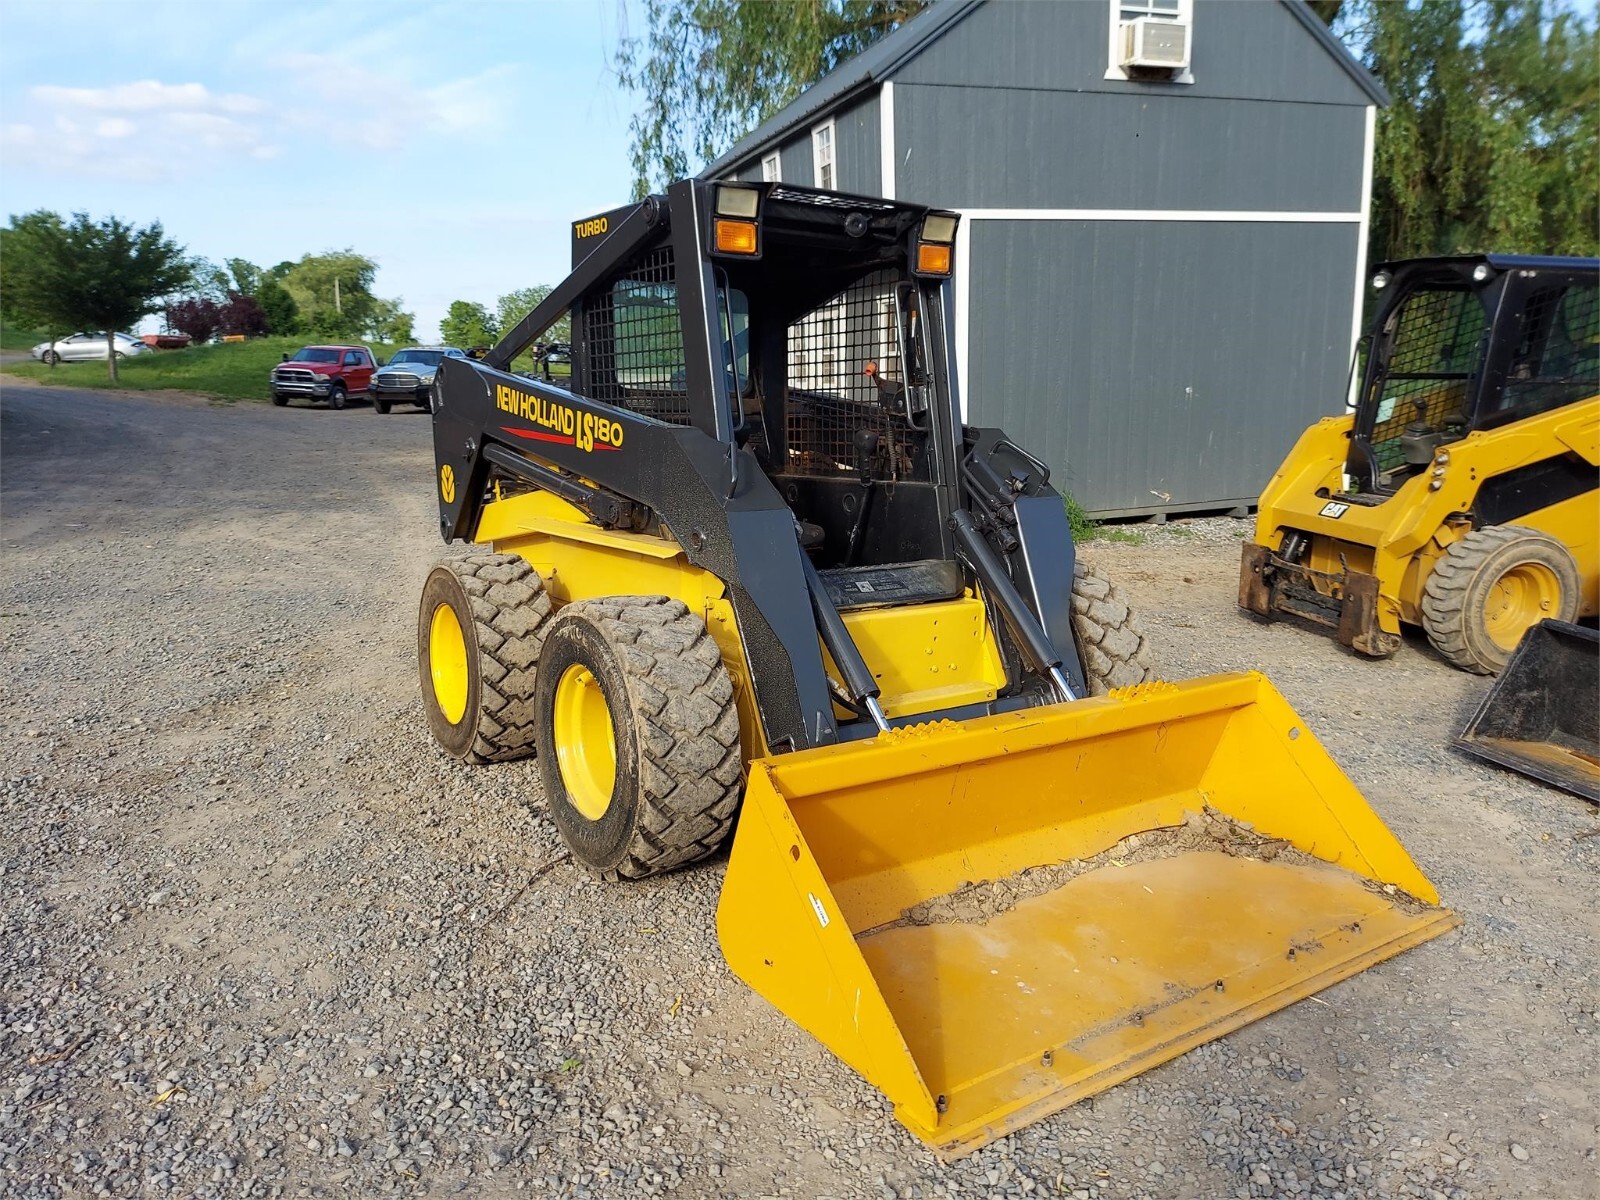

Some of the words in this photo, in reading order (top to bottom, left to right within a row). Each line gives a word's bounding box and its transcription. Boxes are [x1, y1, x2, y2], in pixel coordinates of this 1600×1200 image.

[575, 218, 608, 239] TURBO
[496, 384, 520, 415] NEW
[520, 392, 574, 436] HOLLAND
[1320, 502, 1349, 517] CAT
